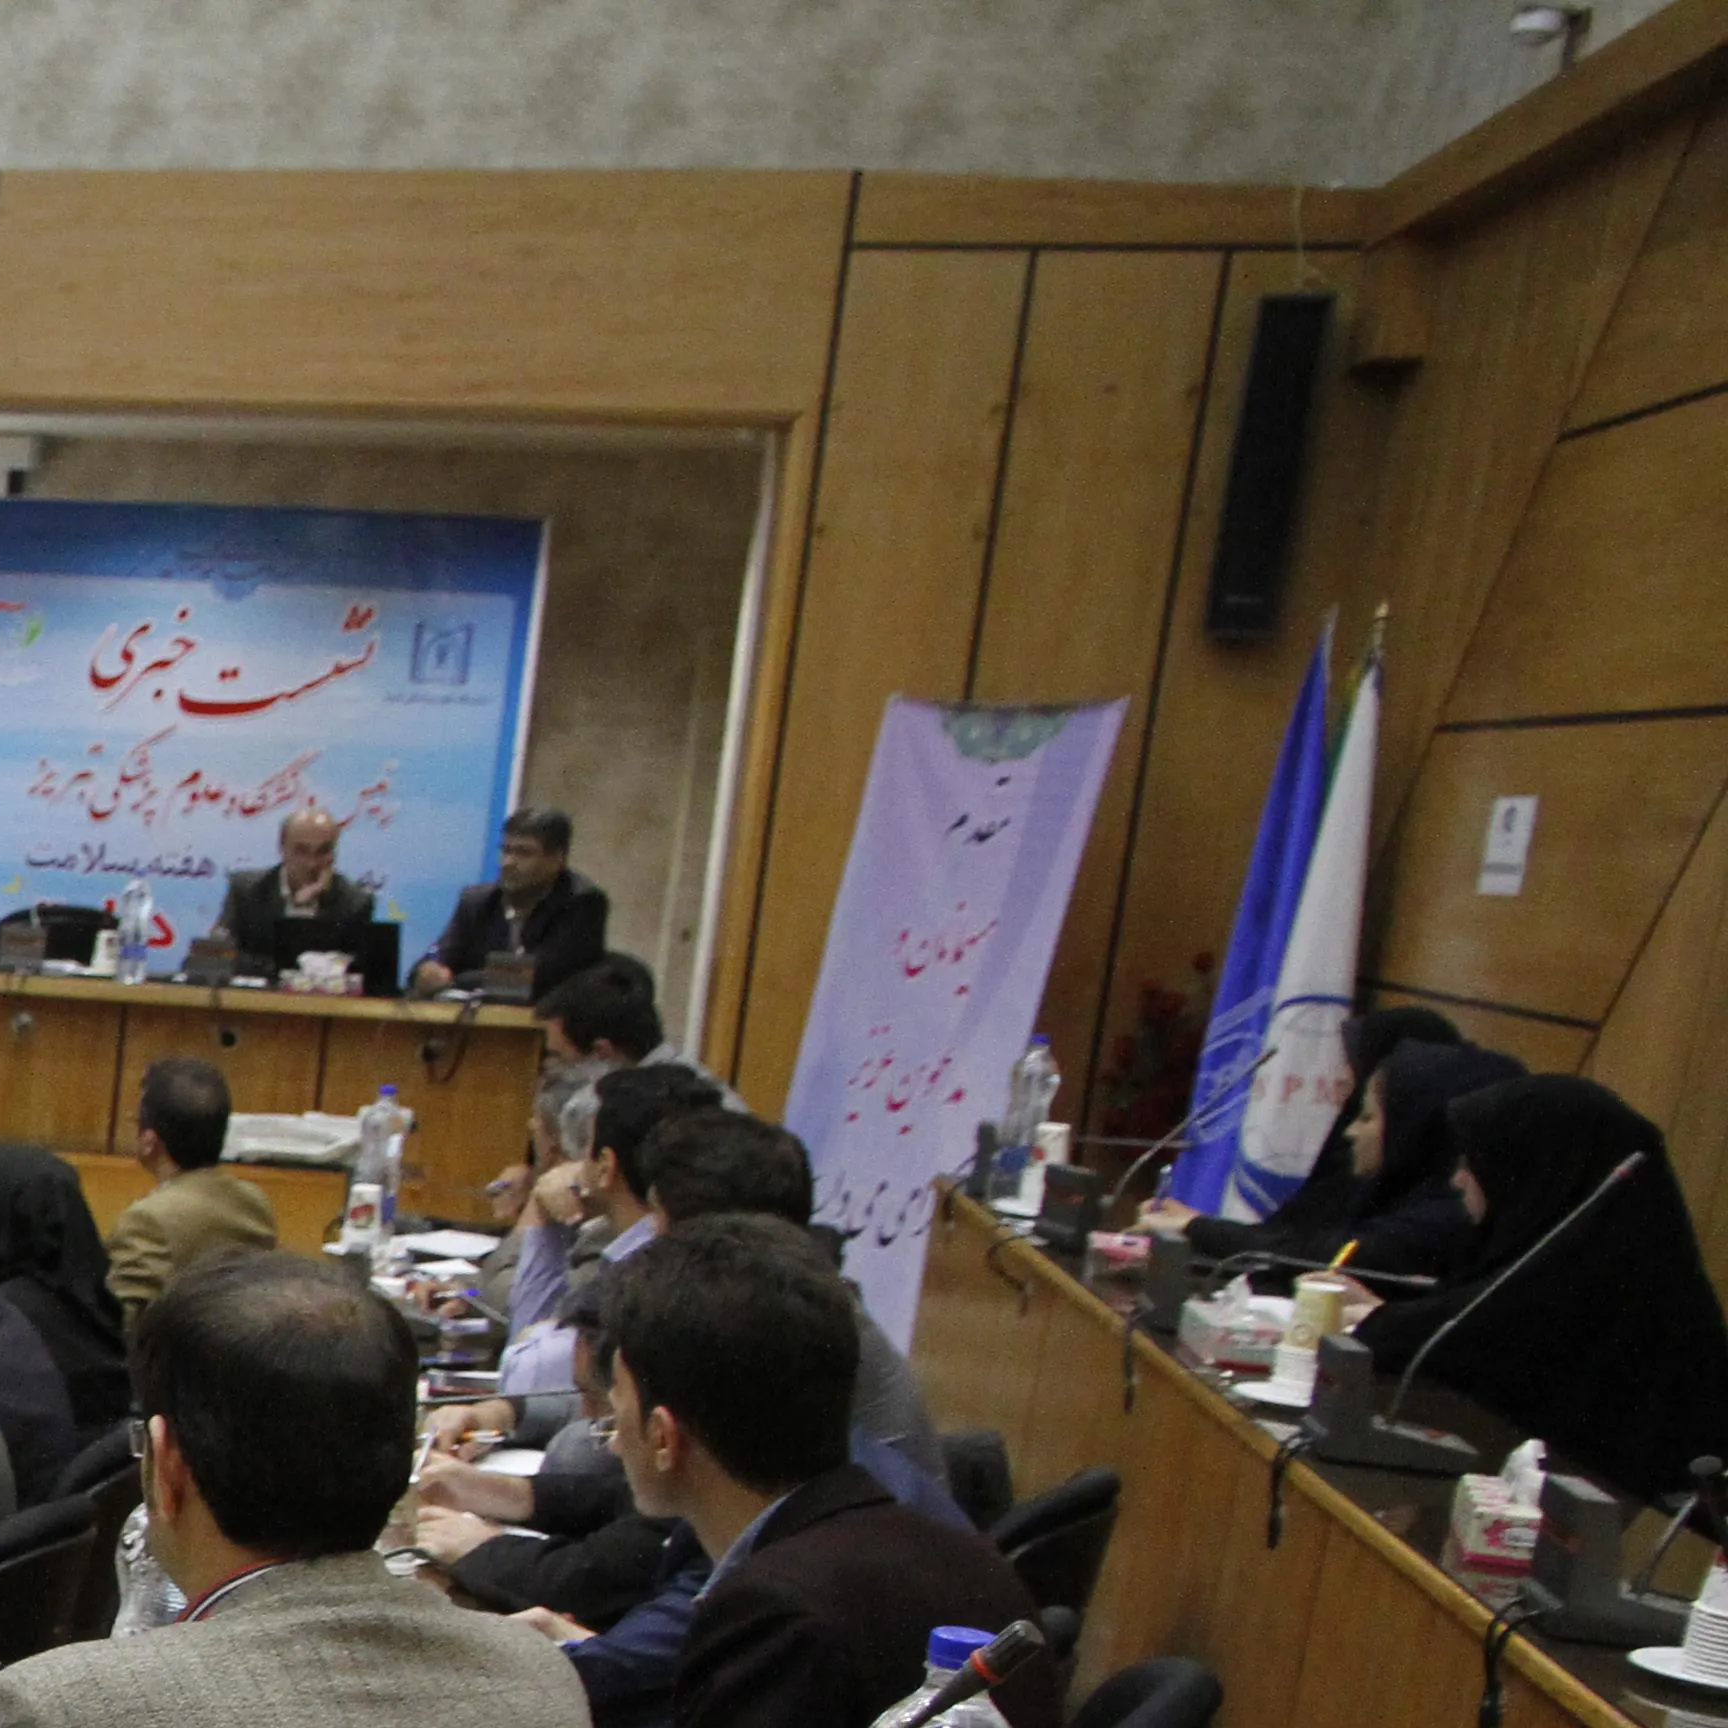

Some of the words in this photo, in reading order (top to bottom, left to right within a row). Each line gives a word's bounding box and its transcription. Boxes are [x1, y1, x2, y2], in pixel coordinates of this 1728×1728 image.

[89, 606, 197, 712] خبری
[179, 604, 380, 716] نشست
[25, 841, 145, 878] سلامت
[146, 844, 216, 880] هفته
